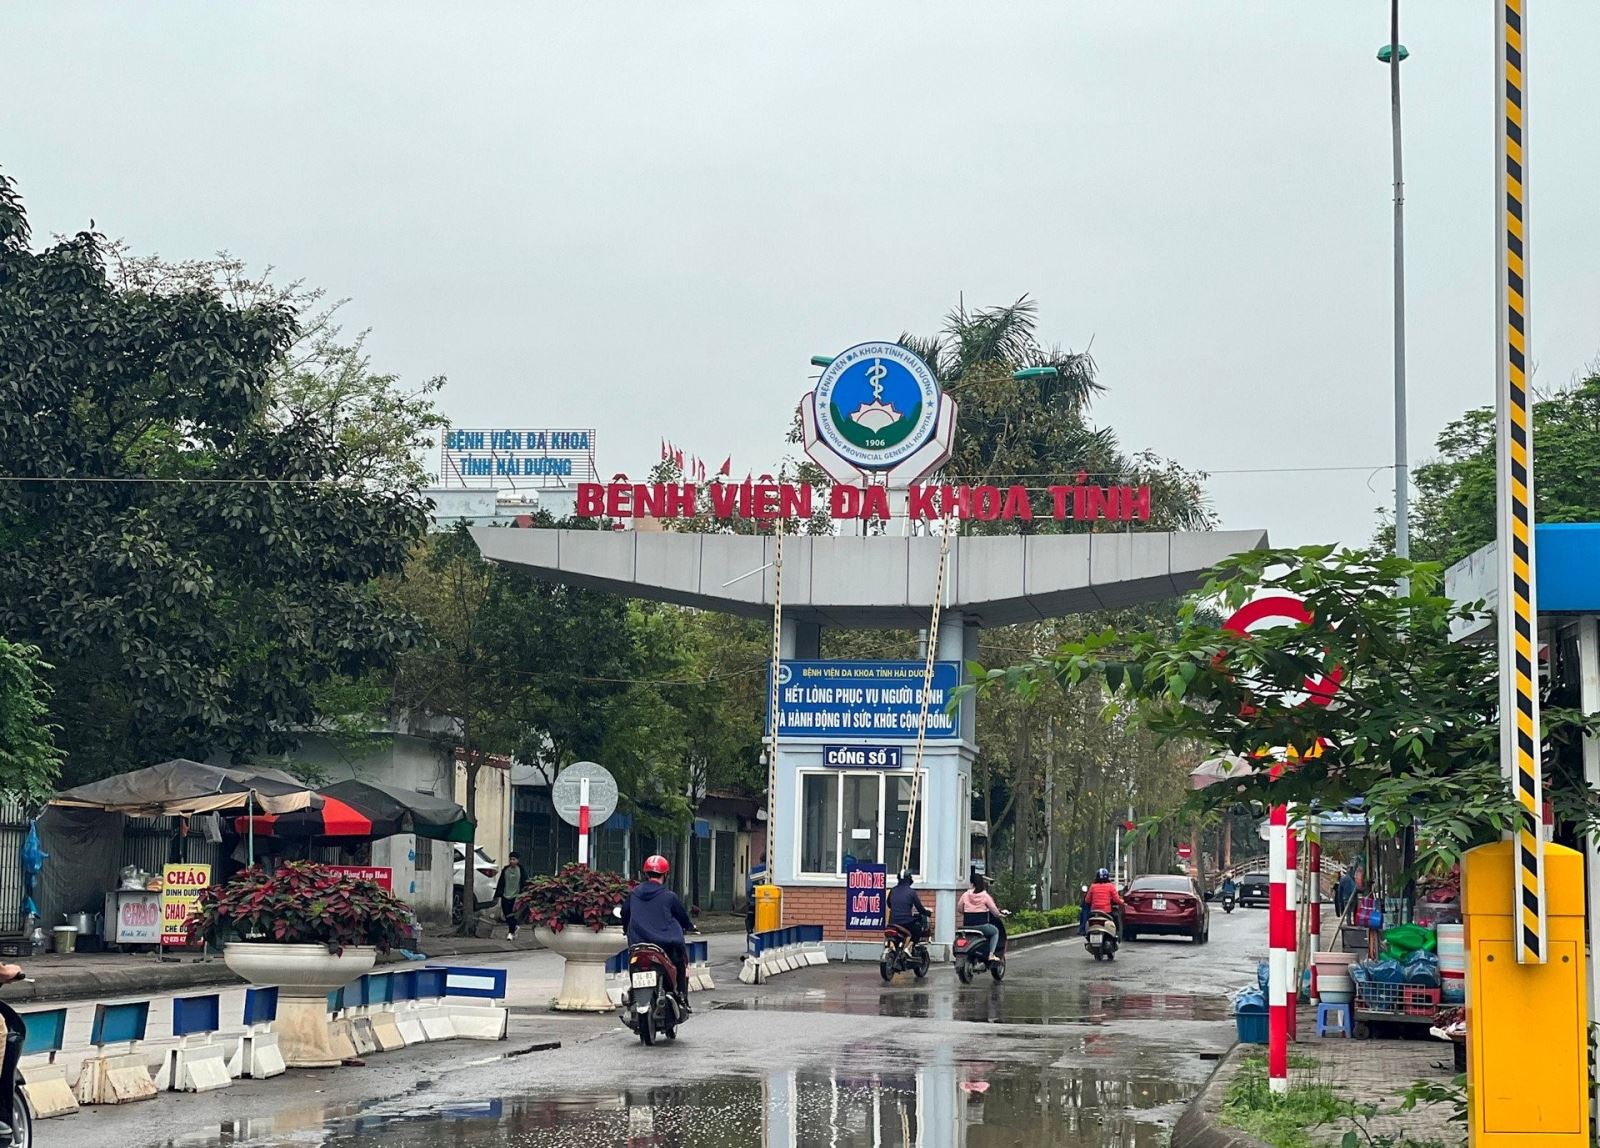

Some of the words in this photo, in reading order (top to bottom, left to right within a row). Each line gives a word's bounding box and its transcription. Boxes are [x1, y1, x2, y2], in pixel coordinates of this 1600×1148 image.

[859, 346, 883, 357] KHOA
[447, 429, 484, 452] BỆNH
[490, 429, 522, 453] VIỆN
[551, 432, 590, 450] KHOA
[841, 444, 884, 461] PROVINCIAL
[883, 441, 915, 460] GENERAL
[912, 412, 933, 444] HOSPITAL
[865, 439, 886, 447] 1906
[459, 453, 493, 476] TỈNH
[496, 452, 520, 476] HẢI
[524, 456, 572, 476] DƯƠNG
[576, 473, 697, 530] BỆNH
[709, 474, 812, 529] VIỆN
[830, 483, 892, 520] ĐA
[908, 484, 1034, 521] KHOA
[1047, 469, 1151, 521] TỈNH
[802, 667, 822, 678] BỆNH
[823, 667, 840, 679] VIỆN
[853, 669, 874, 678] KHOA
[876, 666, 893, 678] TỈNH
[894, 666, 907, 678] HẢI
[908, 668, 935, 678] DƯƠG
[785, 683, 804, 703] HẾT
[806, 684, 833, 704] LÒNG
[835, 688, 863, 707] PHỤC
[865, 688, 879, 707] VỤ
[881, 685, 913, 704] NGƯỜI
[915, 689, 944, 704] BNH
[788, 708, 813, 728] HÀNH
[815, 709, 840, 731] ĐỘNG
[842, 709, 851, 728] VÌ
[853, 708, 872, 728] SỨC
[874, 707, 898, 728] KHỎE
[900, 710, 921, 731] CỘN
[828, 746, 865, 765] CỔNG
[868, 748, 887, 765] SỐ
[890, 752, 897, 765] 1
[167, 868, 206, 884] CHÁO
[849, 869, 872, 888] DỪNG
[873, 872, 884, 888] XE
[165, 901, 185, 920] CHÁO
[853, 891, 868, 912] LẤY
[870, 893, 880, 912] VÉ
[850, 917, 859, 925] Xin
